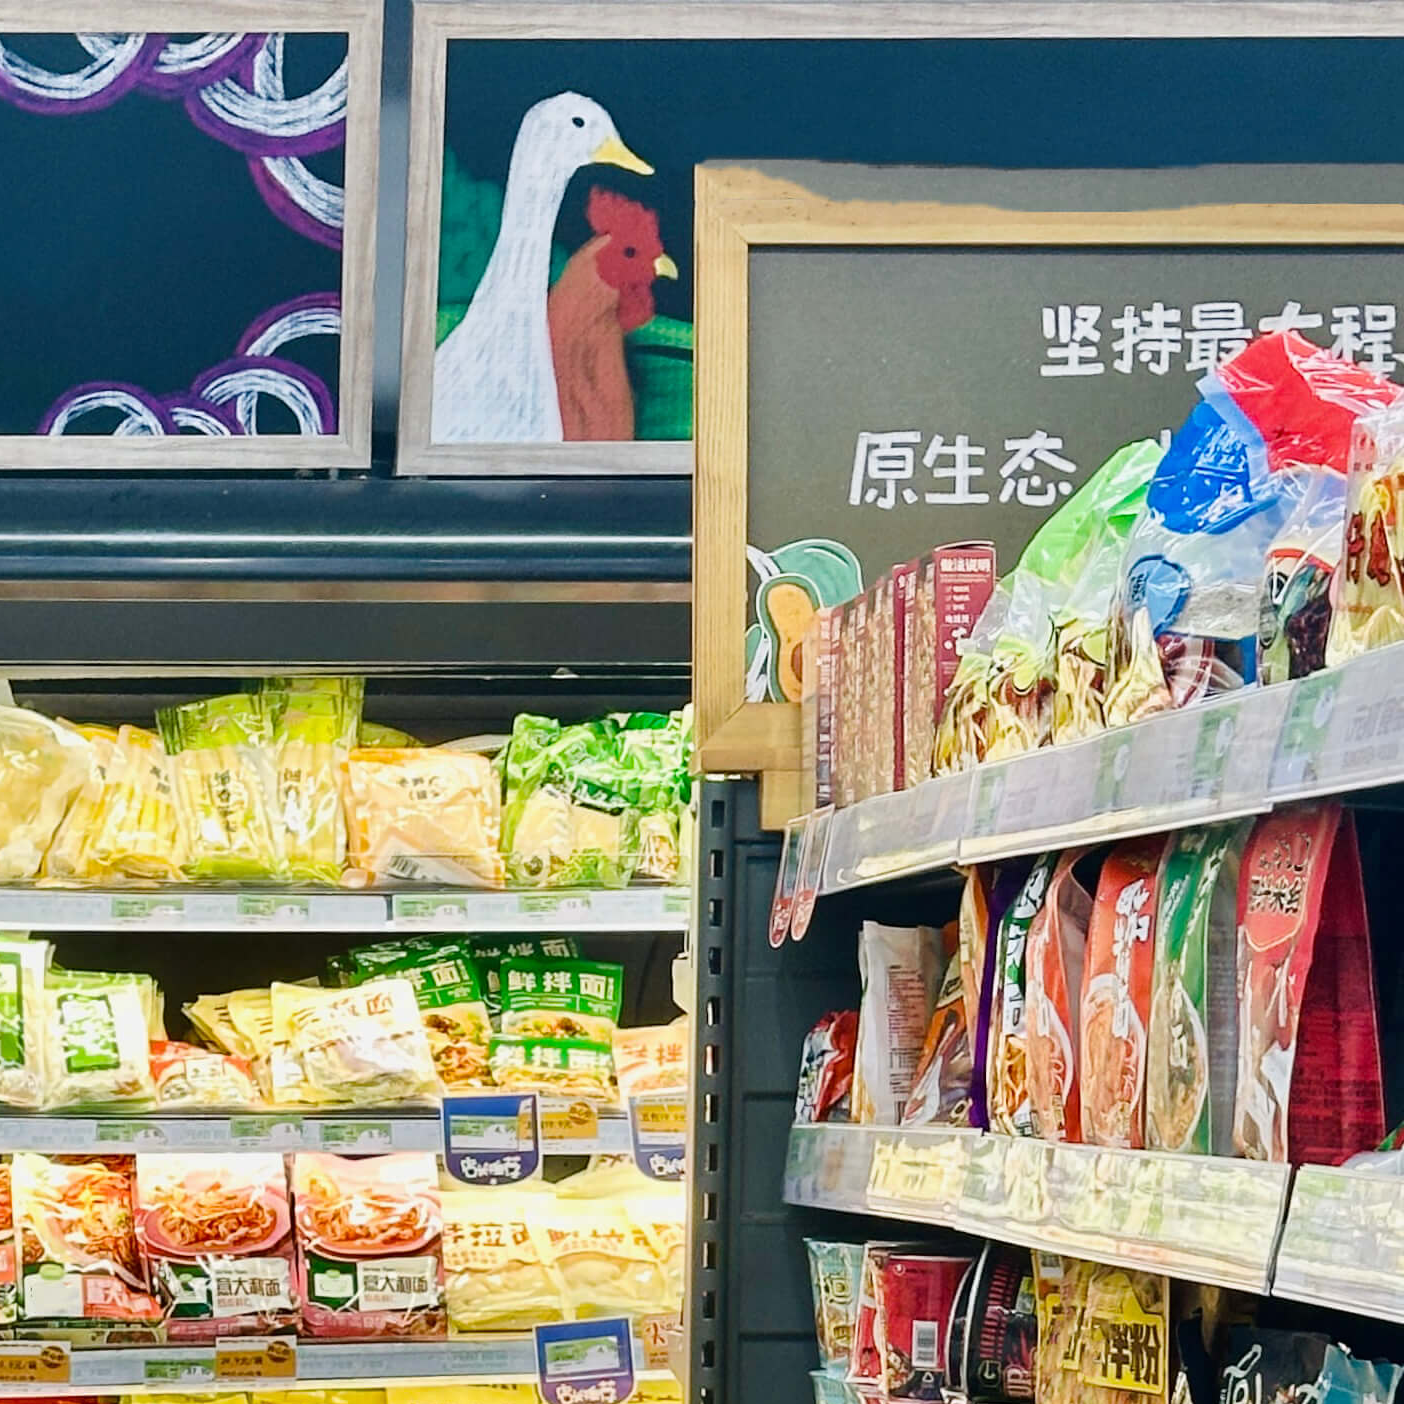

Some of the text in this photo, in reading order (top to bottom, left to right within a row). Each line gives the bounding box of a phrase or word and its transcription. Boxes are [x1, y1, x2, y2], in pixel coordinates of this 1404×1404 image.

[1040, 301, 1404, 376] 坚持最程
[848, 430, 1078, 509] 原生态
[507, 969, 596, 999] 鲜拌面
